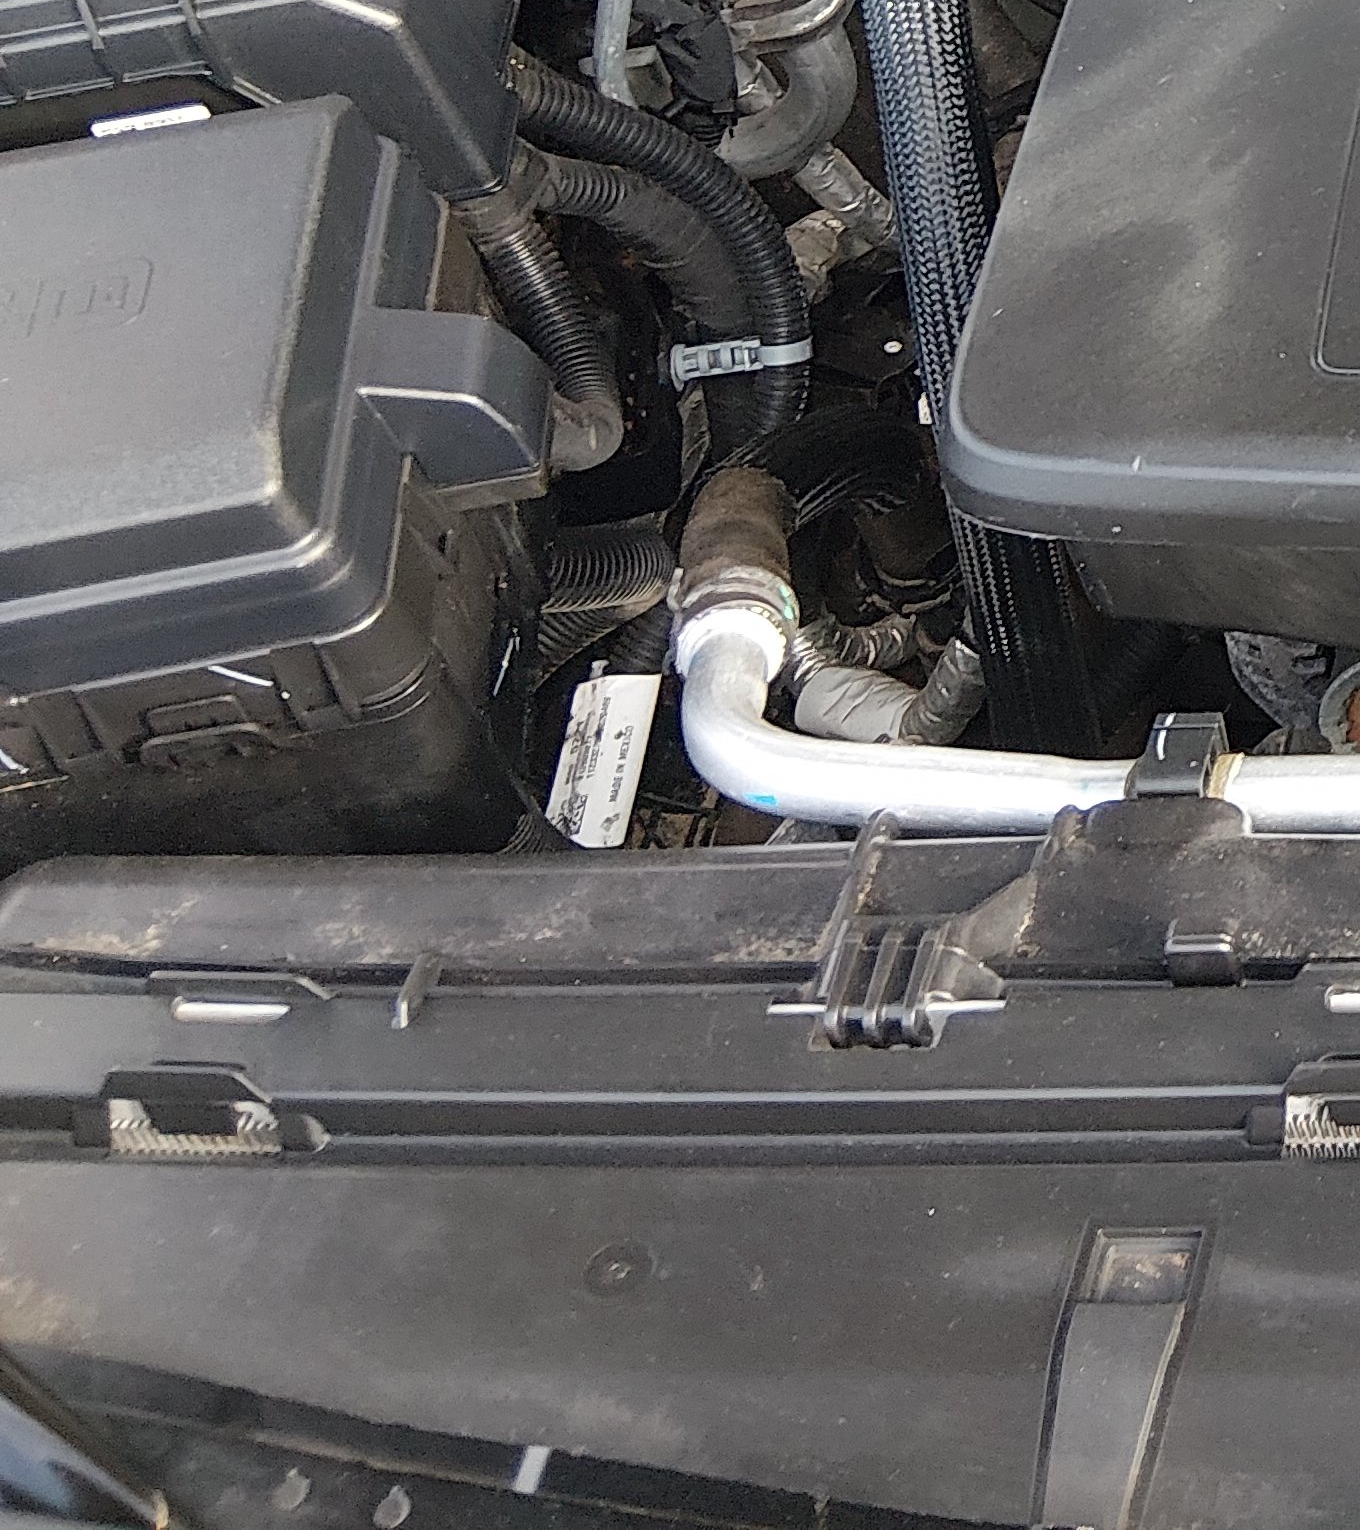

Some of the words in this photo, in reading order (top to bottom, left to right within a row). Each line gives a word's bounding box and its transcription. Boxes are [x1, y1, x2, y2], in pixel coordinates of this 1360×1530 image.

[617, 724, 633, 760] MEXICO
[615, 762, 625, 773] IN
[608, 775, 622, 803] MADE
